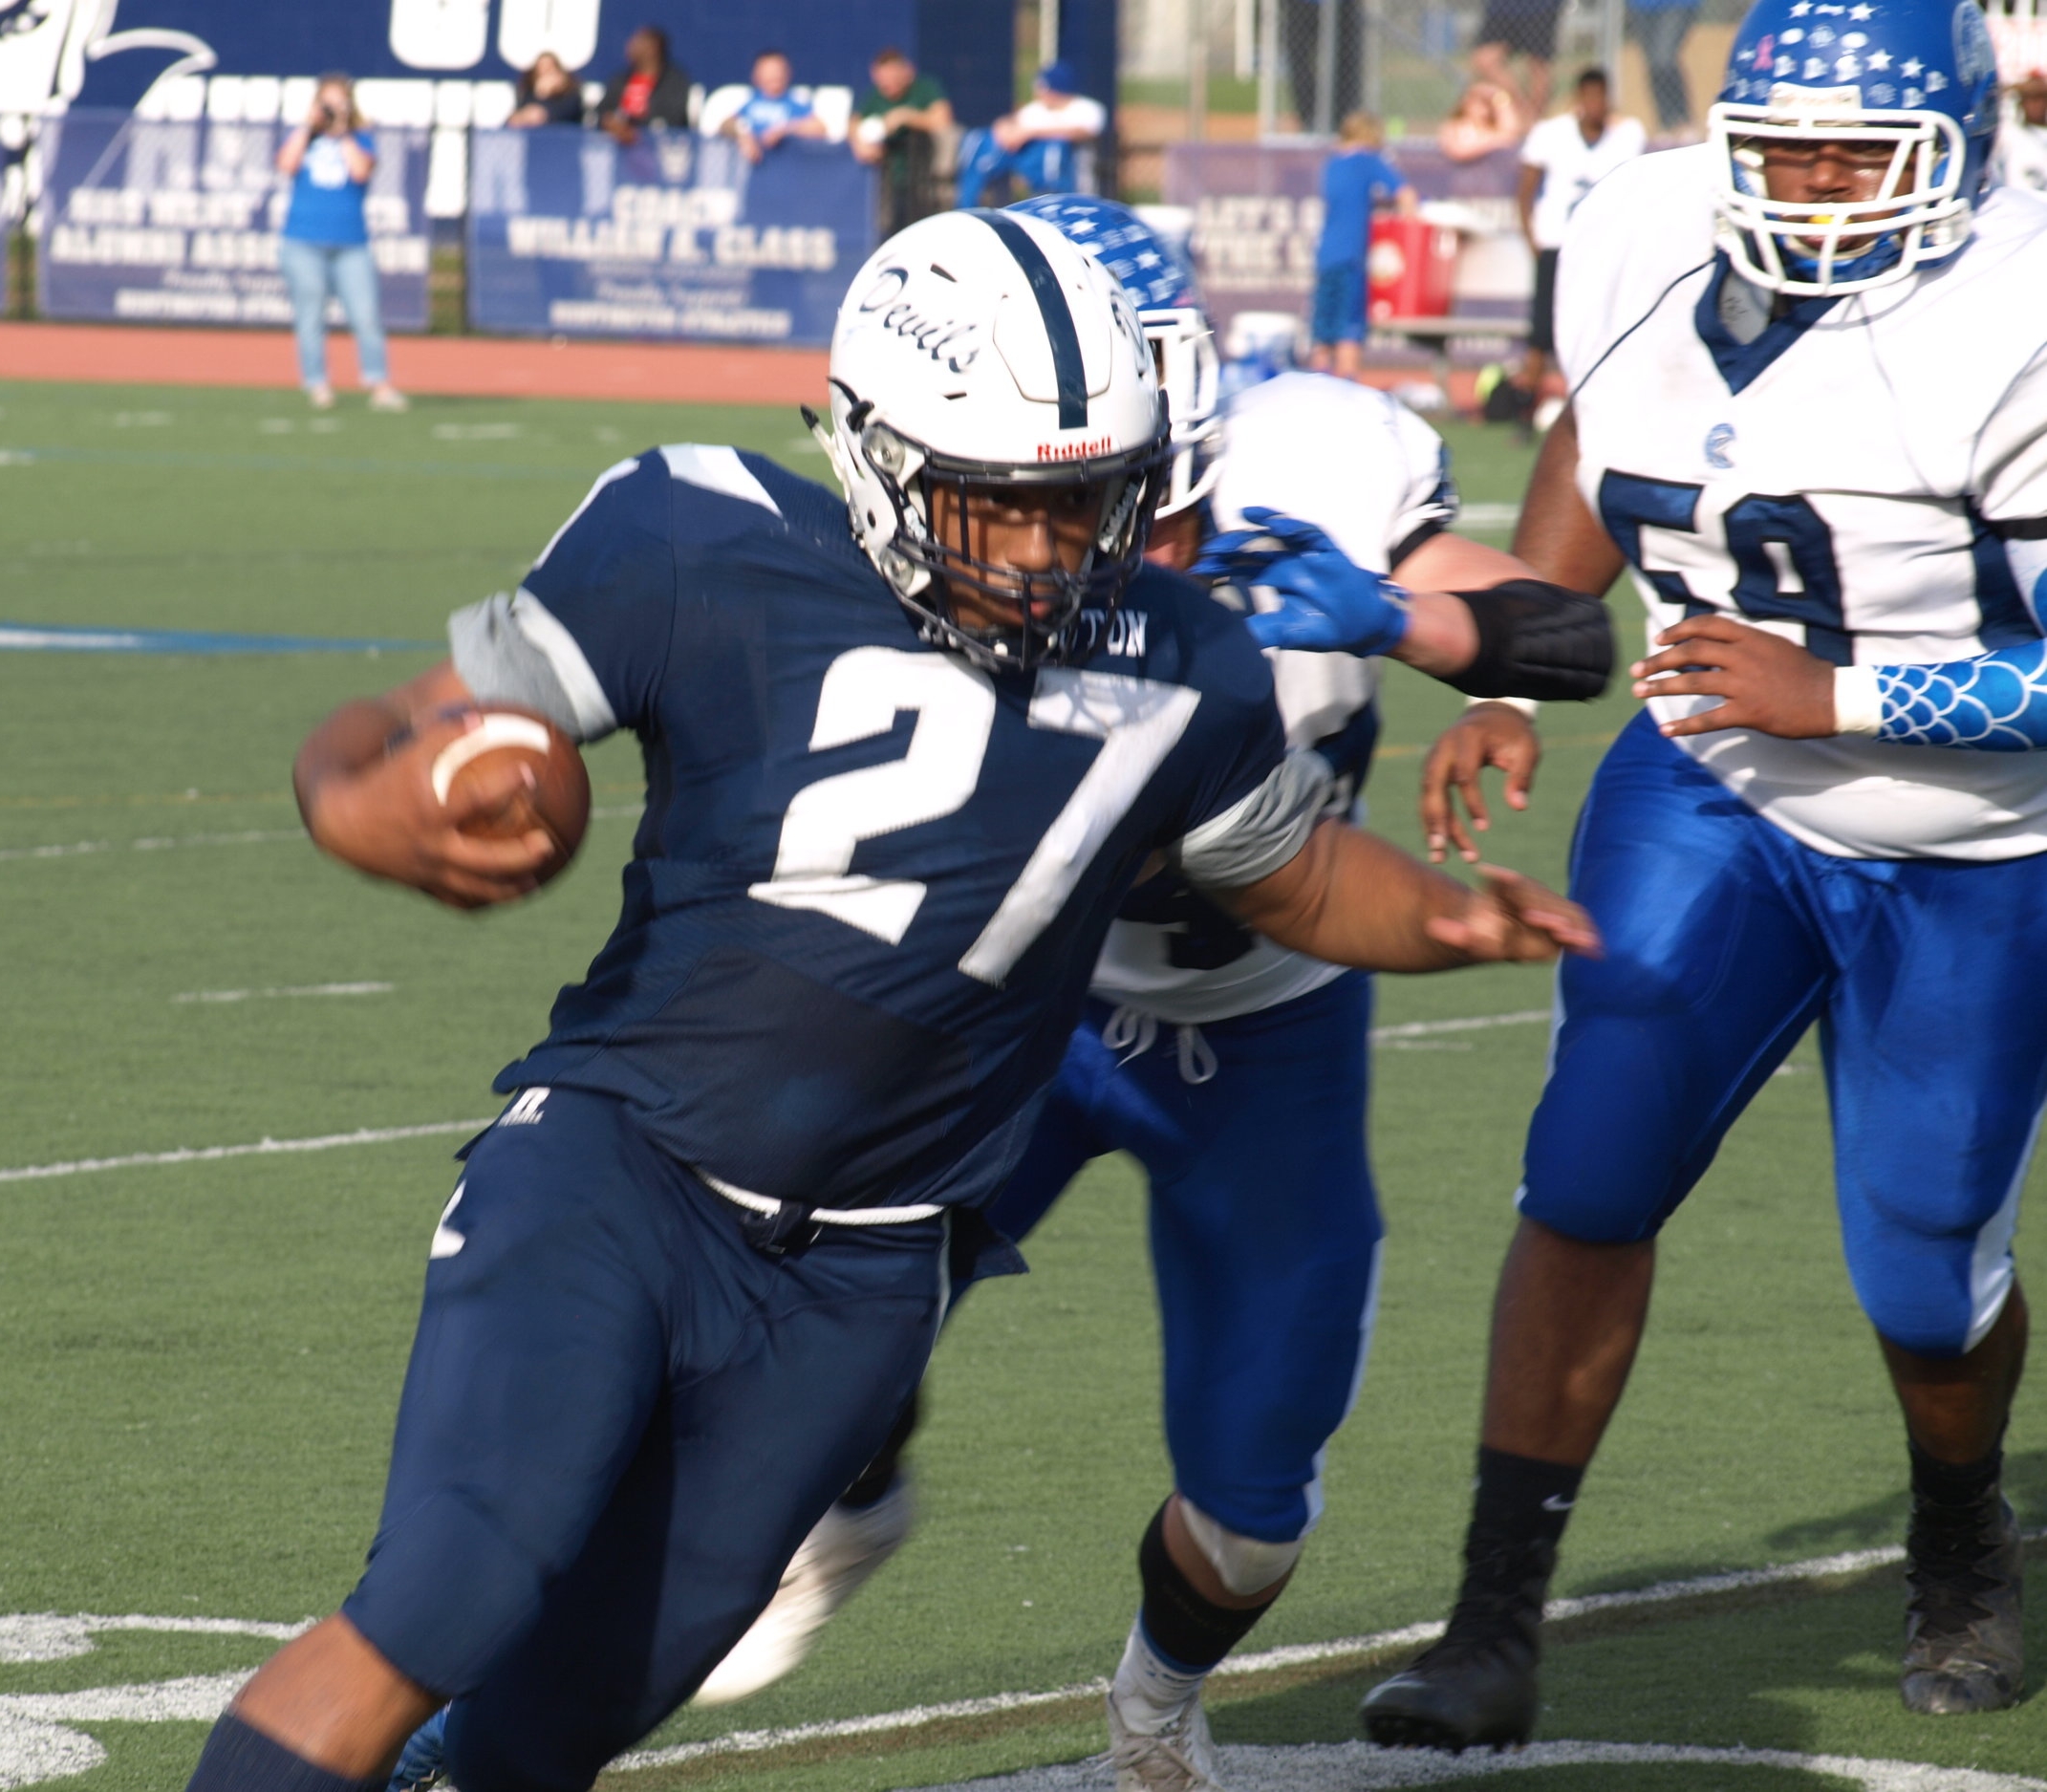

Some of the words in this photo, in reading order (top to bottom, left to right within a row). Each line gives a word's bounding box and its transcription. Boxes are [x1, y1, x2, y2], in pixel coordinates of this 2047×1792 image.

[859, 267, 980, 373] Devils
[1037, 436, 1111, 462] Riddell
[747, 645, 1202, 990] 27
